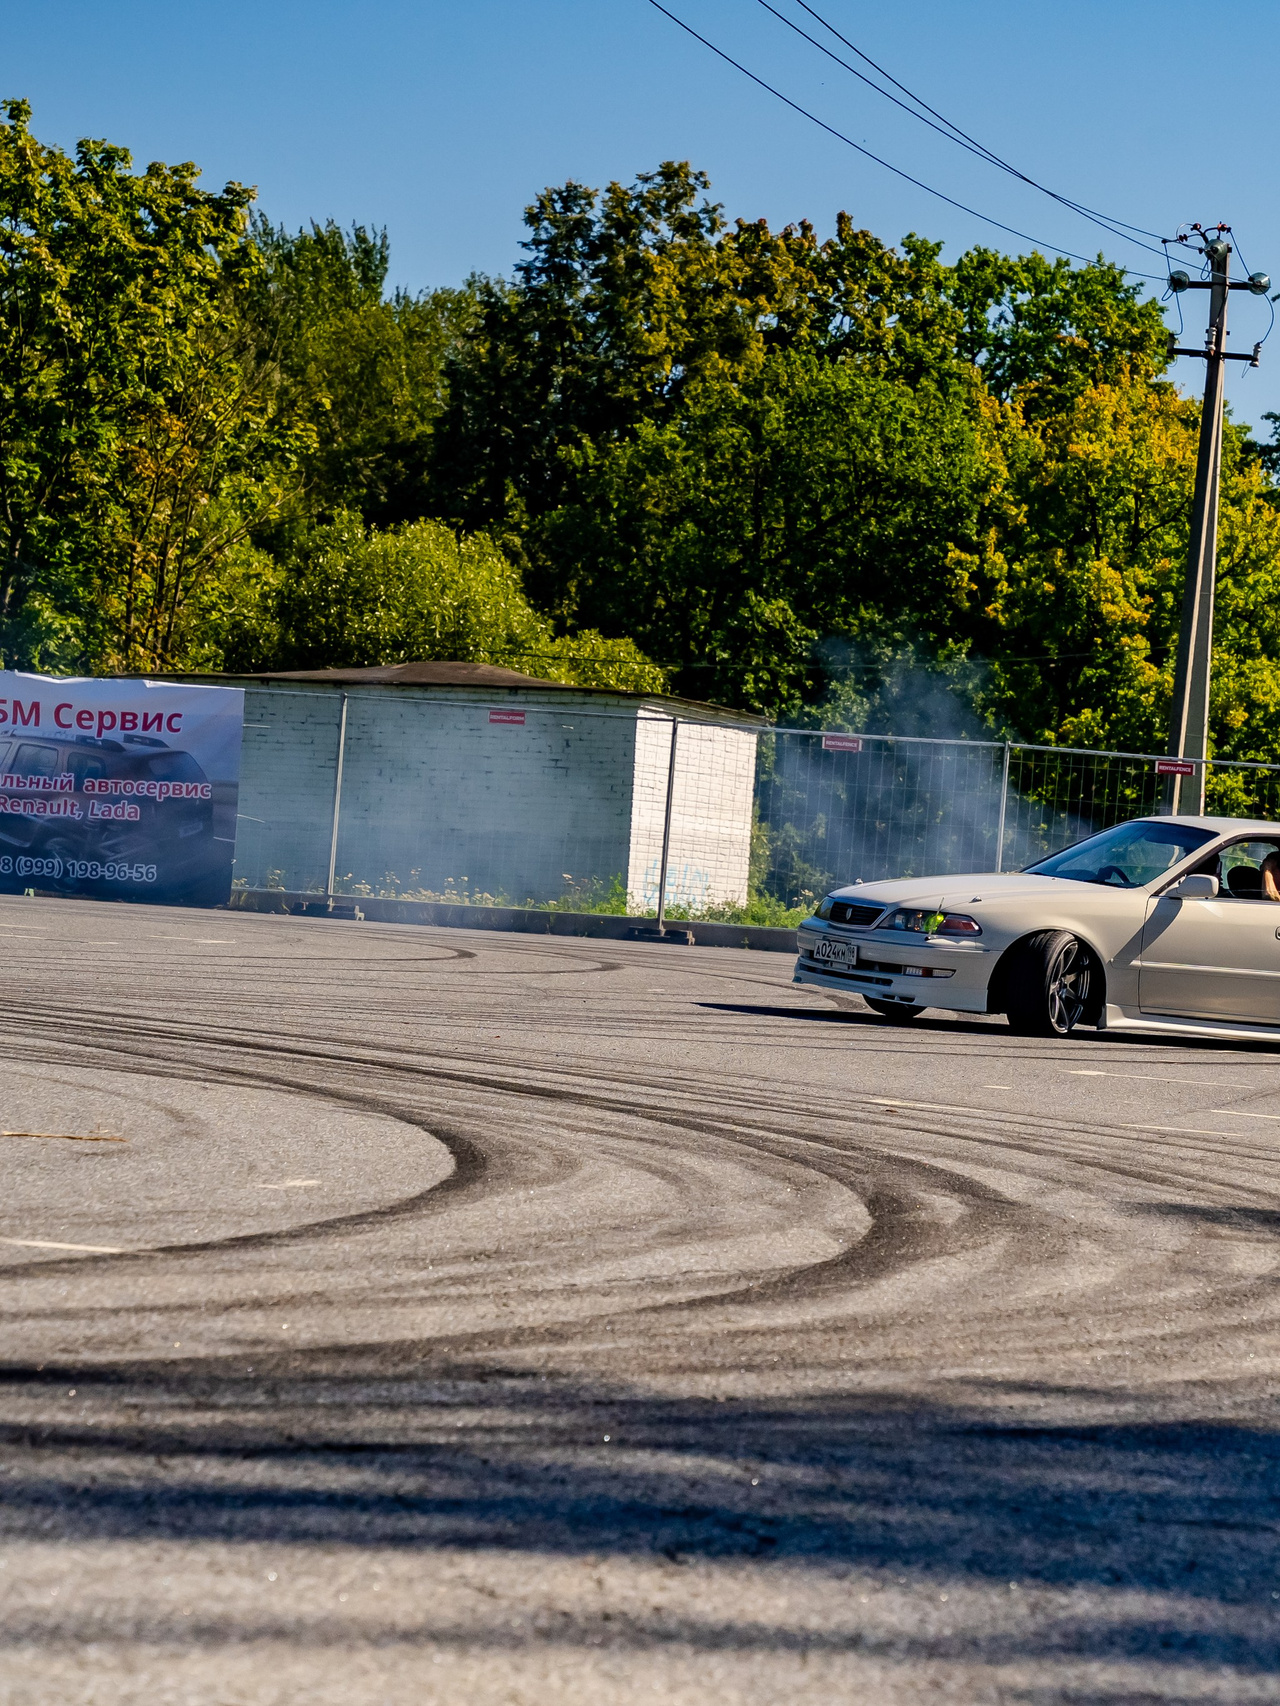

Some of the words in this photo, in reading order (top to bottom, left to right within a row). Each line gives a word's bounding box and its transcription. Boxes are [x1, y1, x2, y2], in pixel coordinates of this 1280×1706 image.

[53, 702, 183, 738] Сервис
[825, 740, 858, 748] RENTALFENCE
[1158, 765, 1192, 773] RENTALFENCE
[83, 778, 212, 802] автосервис
[88, 800, 140, 820] Lada
[0, 856, 13, 873] 8
[16, 856, 63, 878] (999)
[67, 860, 157, 882] 198-96-56
